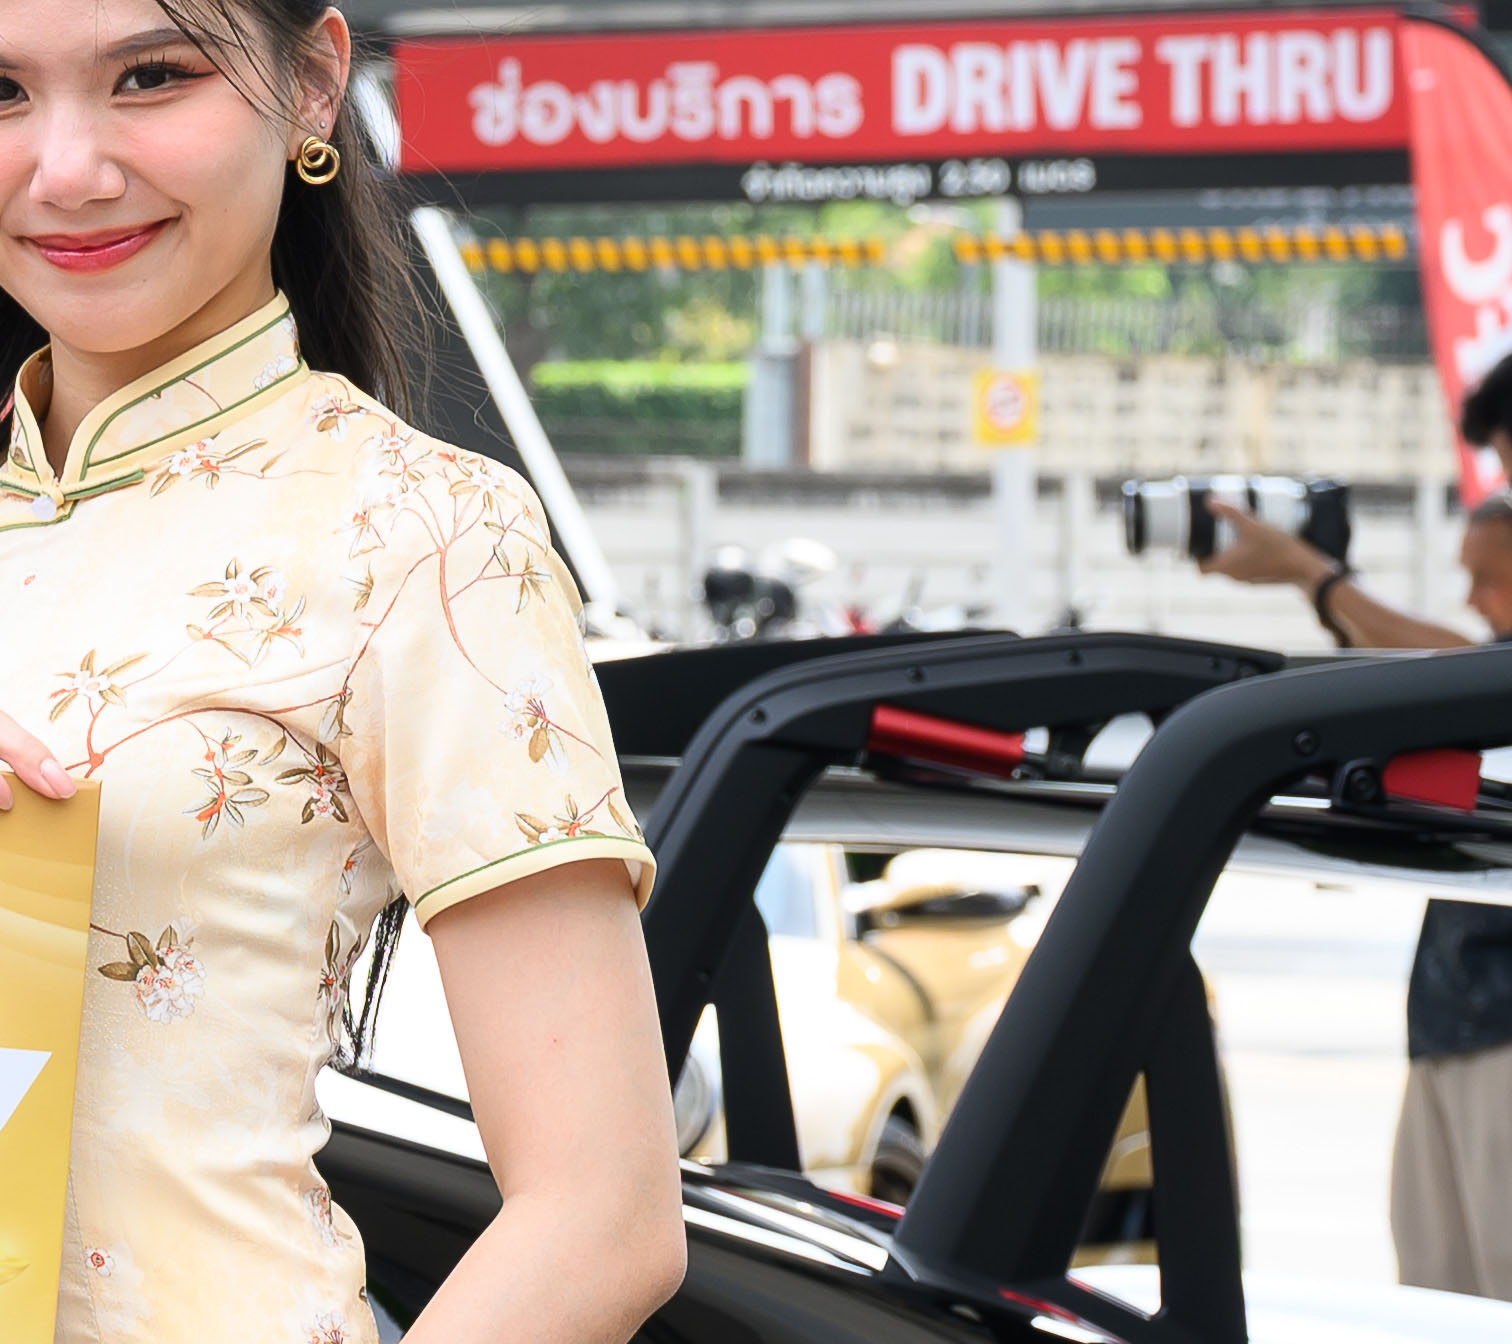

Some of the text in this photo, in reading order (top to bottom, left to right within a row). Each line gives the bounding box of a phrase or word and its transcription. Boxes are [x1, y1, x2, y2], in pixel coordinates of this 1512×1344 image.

[468, 27, 1393, 147] ช่องบริการ DRIVE THRU
